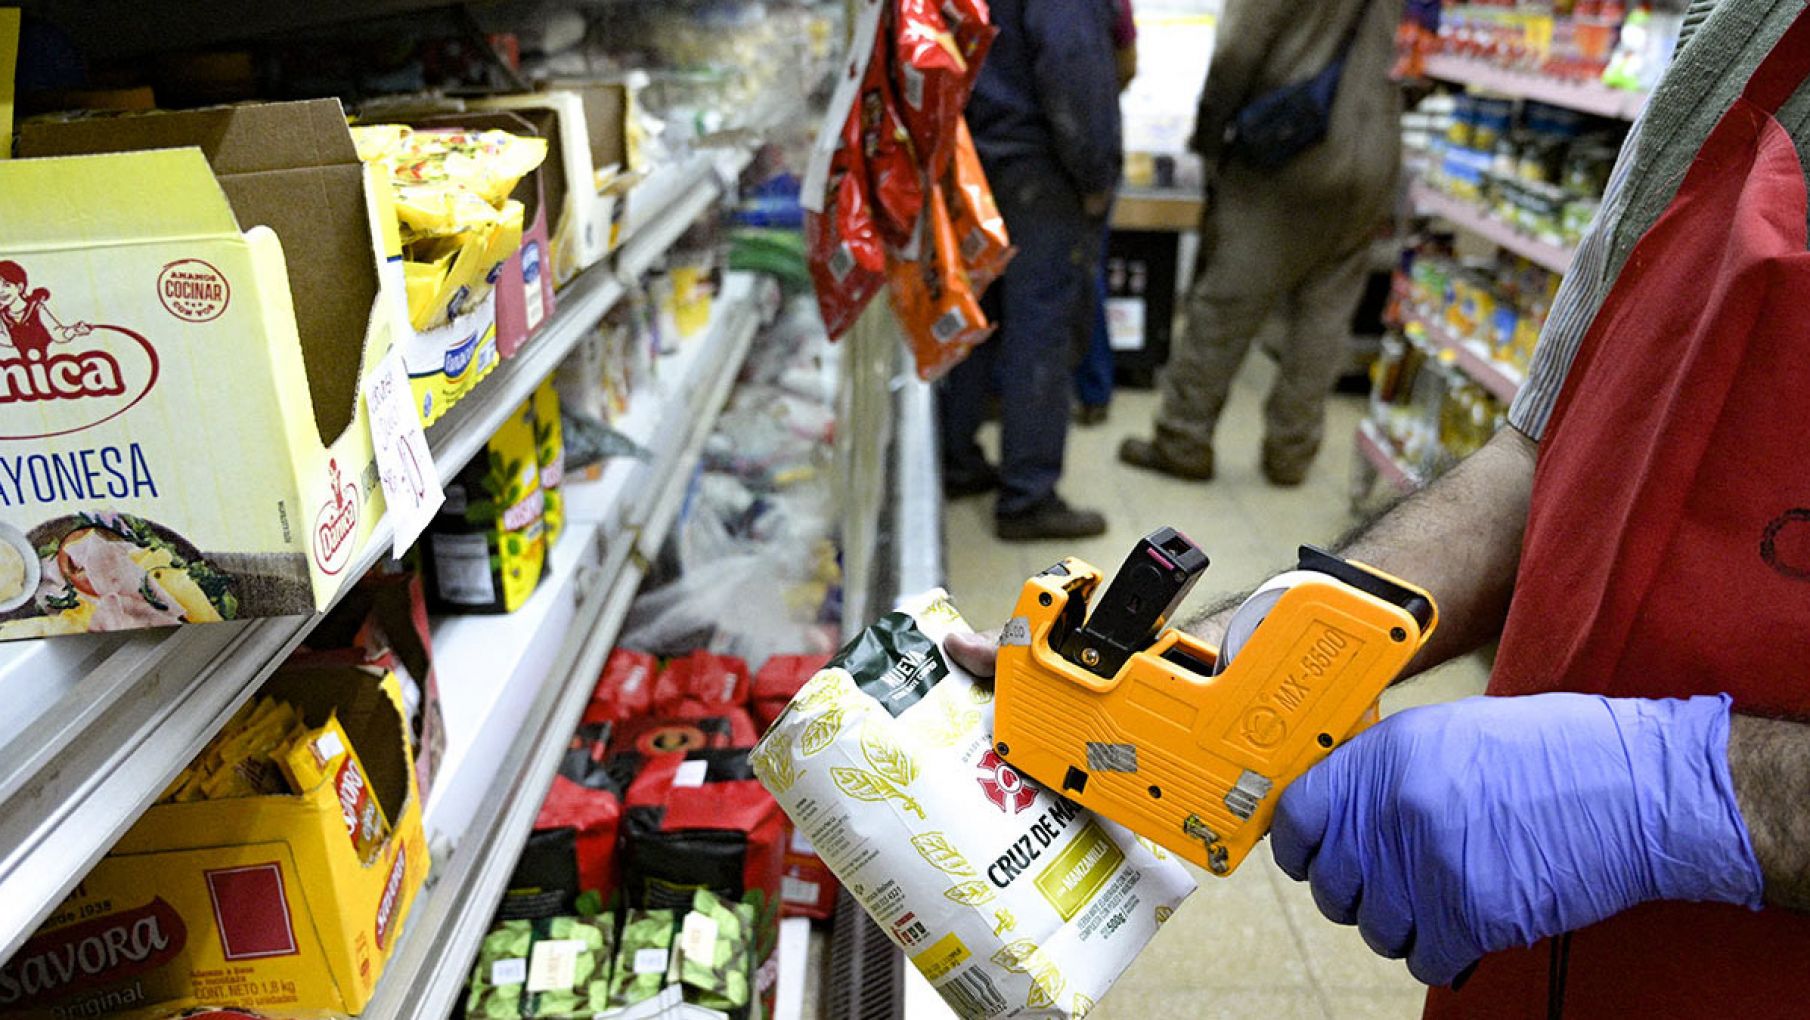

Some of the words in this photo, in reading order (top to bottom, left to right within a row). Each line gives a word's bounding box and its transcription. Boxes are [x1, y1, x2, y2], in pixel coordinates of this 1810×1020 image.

[165, 279, 222, 302] COCINAR
[0, 442, 159, 507] YONESA
[880, 650, 927, 689] NUEVA
[987, 834, 1041, 889] CRUZ
[1029, 813, 1061, 848] DE
[1062, 839, 1110, 892] MANZANILLA
